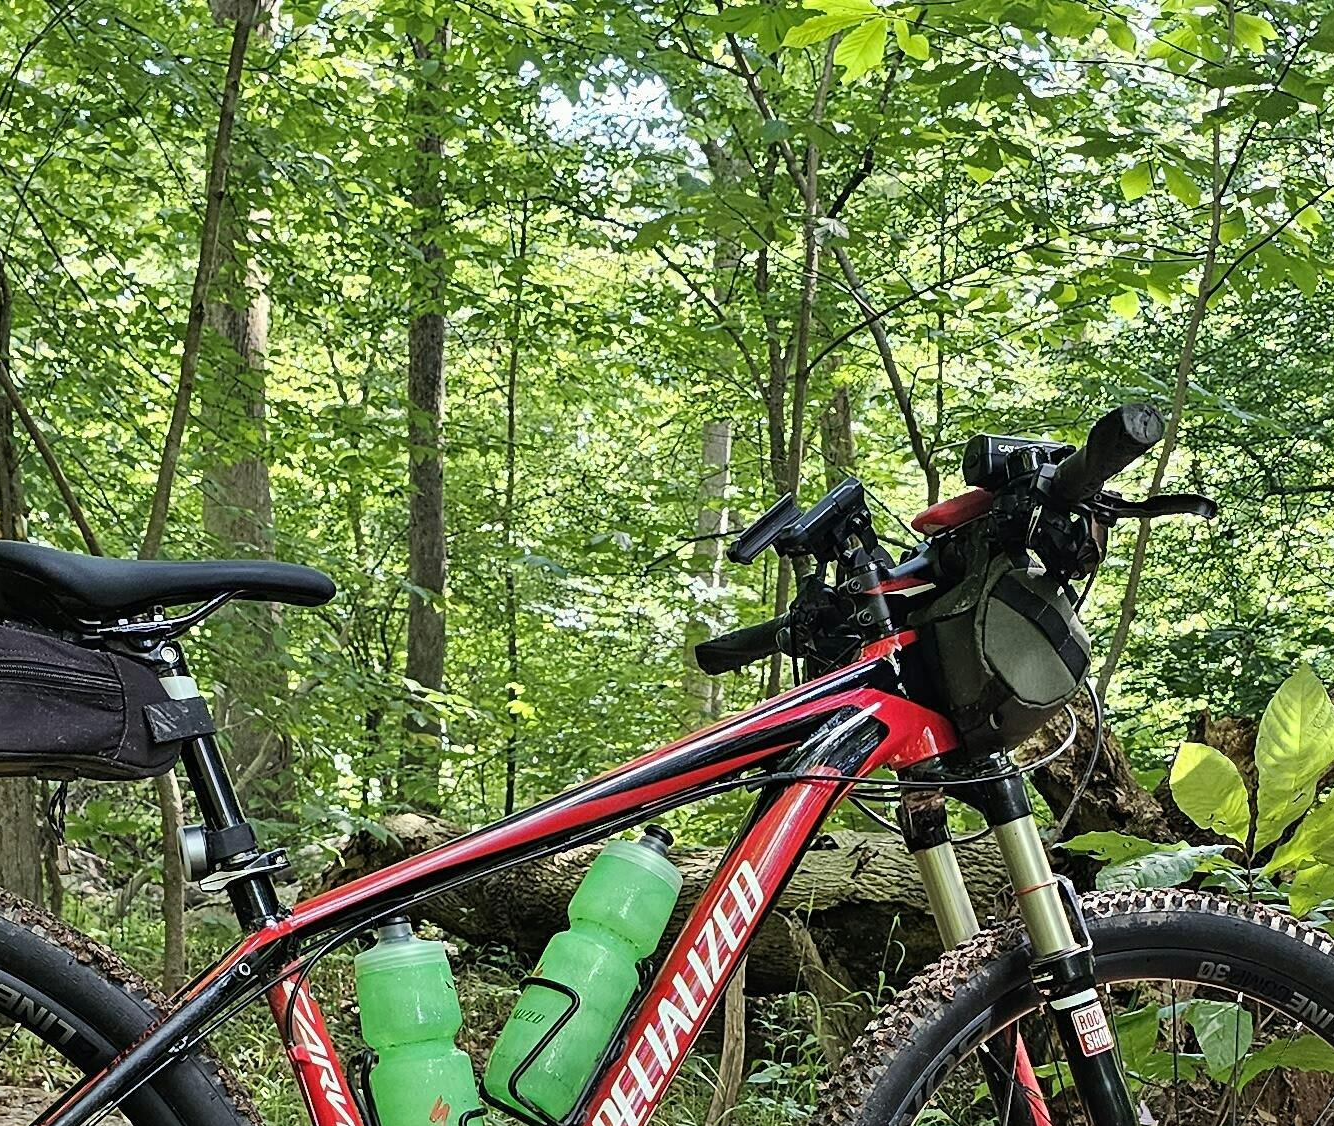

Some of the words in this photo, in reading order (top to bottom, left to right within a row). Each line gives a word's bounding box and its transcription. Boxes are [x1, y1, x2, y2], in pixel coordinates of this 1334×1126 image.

[1197, 961, 1231, 982] 30
[1078, 1010, 1102, 1031] ROC
[1084, 1029, 1113, 1051] SHO
